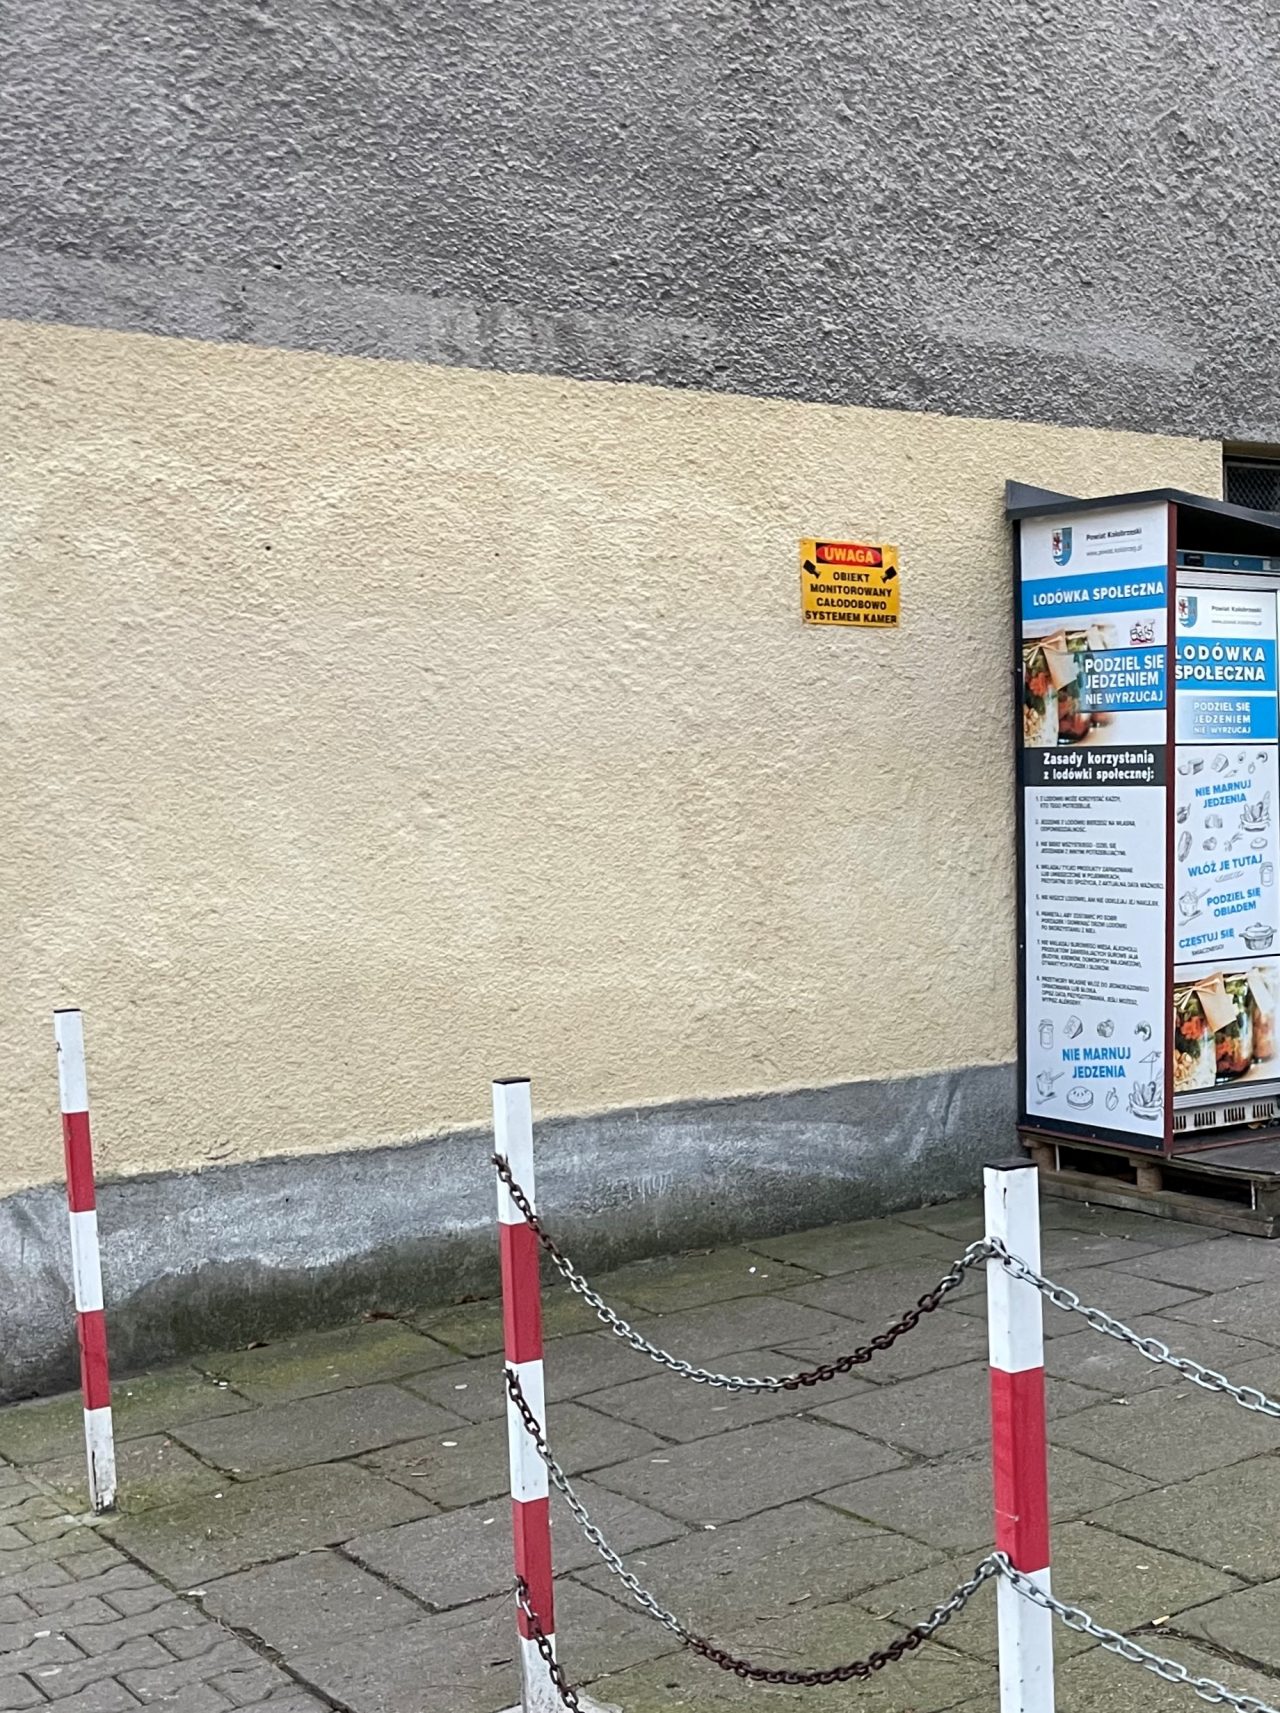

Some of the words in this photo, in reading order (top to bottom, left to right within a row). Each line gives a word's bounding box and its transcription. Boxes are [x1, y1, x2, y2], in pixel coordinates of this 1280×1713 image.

[824, 547, 874, 563] UWAGA
[833, 572, 870, 582] OBIEKT
[810, 584, 892, 597] MONITOROWANY
[816, 597, 887, 610] CAŁODOBOWO
[805, 610, 861, 622] SYSTEMEM
[863, 613, 897, 623] KAMER
[1175, 642, 1265, 662] LODÓWKA
[1085, 656, 1141, 673] PODZIEL
[1143, 654, 1164, 673] SIĘ
[1085, 671, 1159, 689] JEDZENIEM
[1175, 664, 1265, 681] SPOŁECZNA
[1085, 693, 1103, 705] NIE
[1105, 690, 1163, 704] WYRZUCAJ
[1194, 702, 1234, 712] PODZIEL
[1194, 714, 1251, 724] JEDZENIEM
[1210, 726, 1251, 734] WYRZUCAJ
[1043, 751, 1083, 768] Zasady
[1087, 749, 1155, 767] korzystania
[1043, 771, 1049, 780] z
[1052, 767, 1092, 780] lodówki
[1096, 766, 1155, 782] społecznej:
[1195, 786, 1211, 797] NIE
[1212, 779, 1252, 795] MARNUJ
[1203, 793, 1247, 809] JEDZENIA
[1219, 860, 1231, 871] JE
[1232, 853, 1263, 869] TUTAJ
[1206, 891, 1246, 907] PODZIEL
[1213, 900, 1257, 918] OBIADEM
[1062, 1048, 1081, 1062] NIE
[1083, 1047, 1132, 1061] MARNUJ
[1072, 1065, 1127, 1079] JEDZENIA
